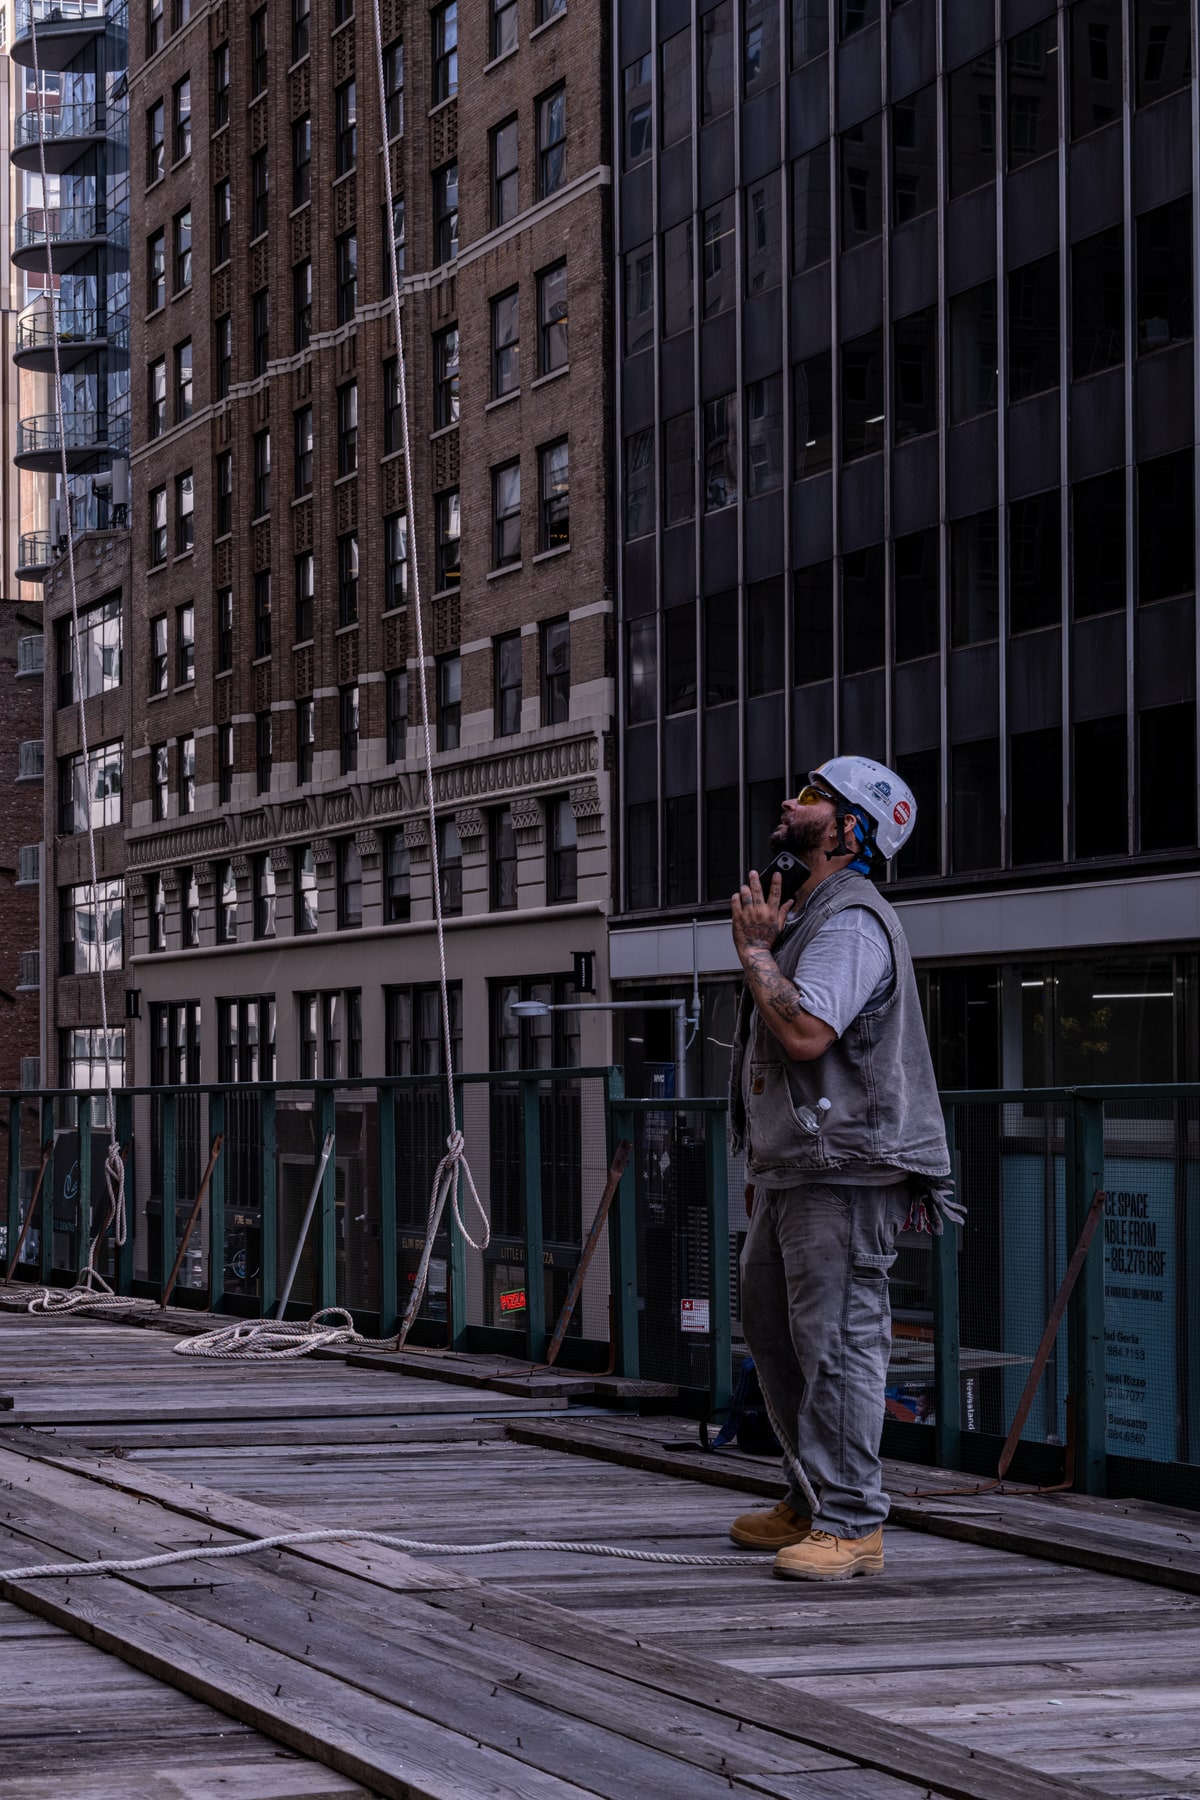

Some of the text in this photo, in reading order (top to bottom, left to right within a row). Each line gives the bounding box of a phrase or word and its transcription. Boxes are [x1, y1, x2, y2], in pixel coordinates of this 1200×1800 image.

[653, 1074, 665, 1083] NYC
[1118, 1192, 1149, 1219] SPACE
[1129, 1220, 1157, 1248] FROM
[501, 1247, 519, 1260] LITTLE
[1147, 1250, 1167, 1277] RSF
[499, 1291, 526, 1311] PIZZA
[1123, 1374, 1146, 1388] Rizzo
[966, 1377, 976, 1430] Newsstand
